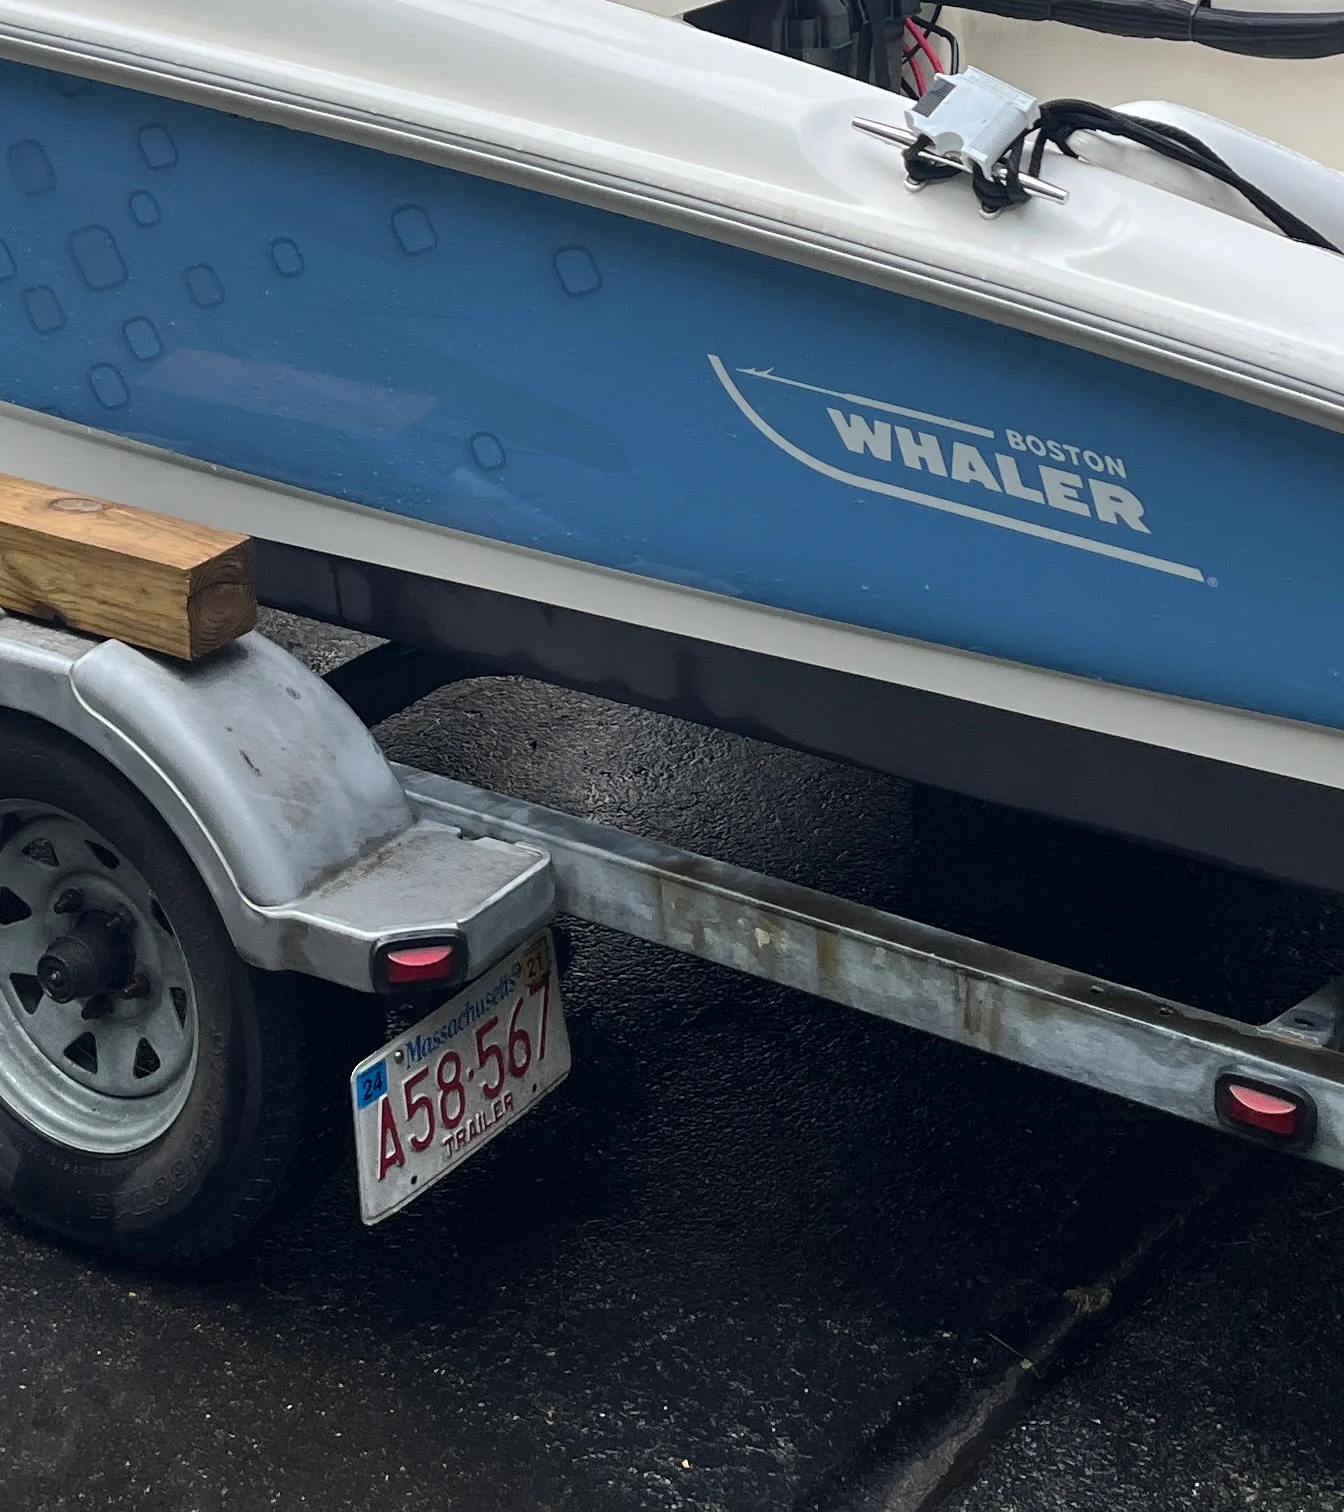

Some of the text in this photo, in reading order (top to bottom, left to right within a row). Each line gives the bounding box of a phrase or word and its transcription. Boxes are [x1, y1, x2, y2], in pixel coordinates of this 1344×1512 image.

[825, 406, 1152, 535] WHALER
[1006, 429, 1127, 479] BOSTON
[405, 975, 517, 1068] Massachusetts
[362, 1072, 384, 1102] 24
[441, 1091, 514, 1161] TRAILER
